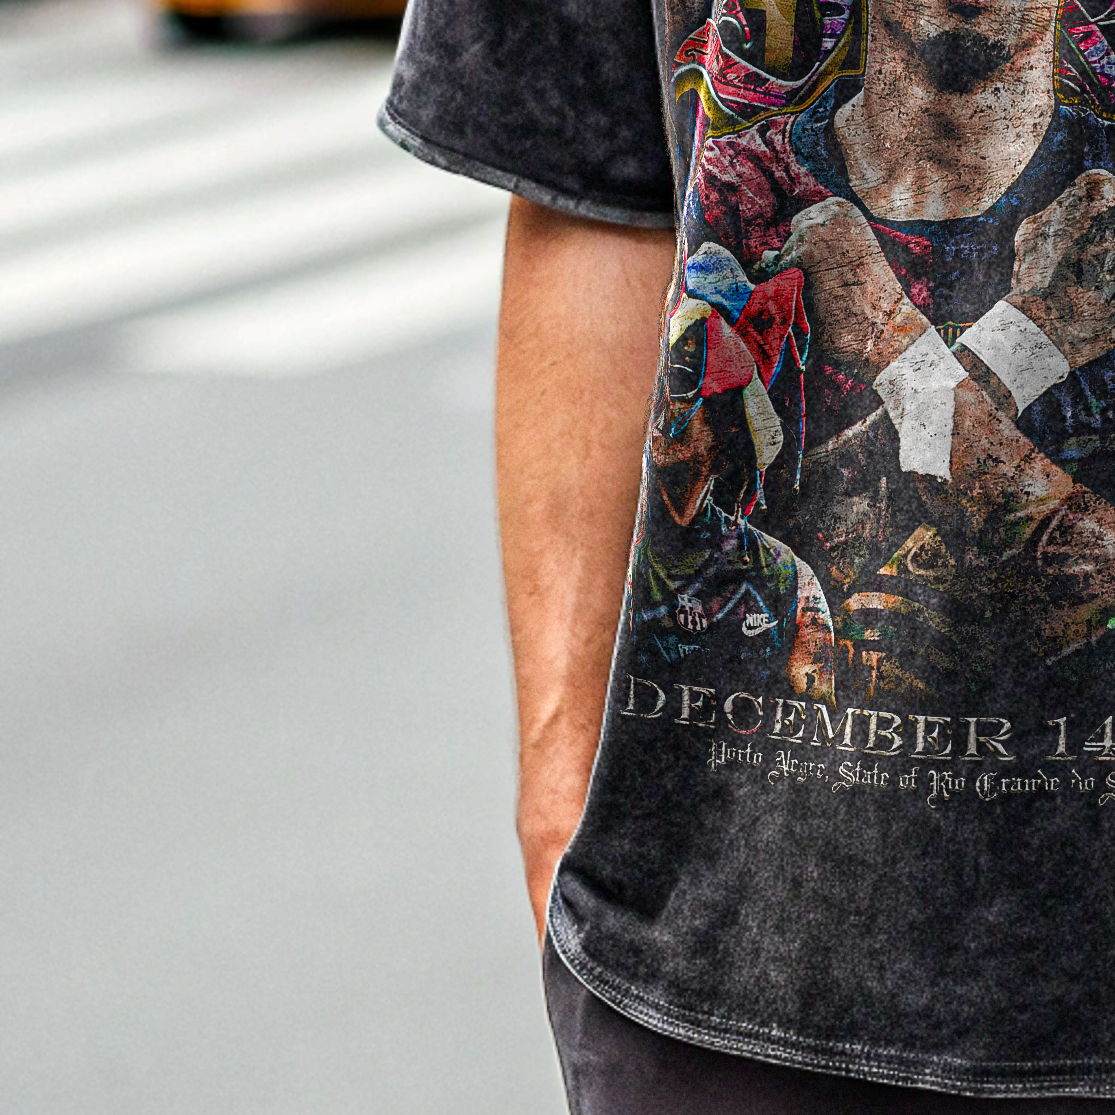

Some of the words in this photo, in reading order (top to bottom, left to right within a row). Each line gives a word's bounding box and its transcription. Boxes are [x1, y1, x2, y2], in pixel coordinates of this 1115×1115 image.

[746, 613, 770, 627] NIKE
[619, 673, 1017, 761] DECEMBER
[706, 738, 763, 773] Porto
[831, 760, 890, 794] State
[899, 766, 920, 790] of
[926, 770, 967, 808] Rio
